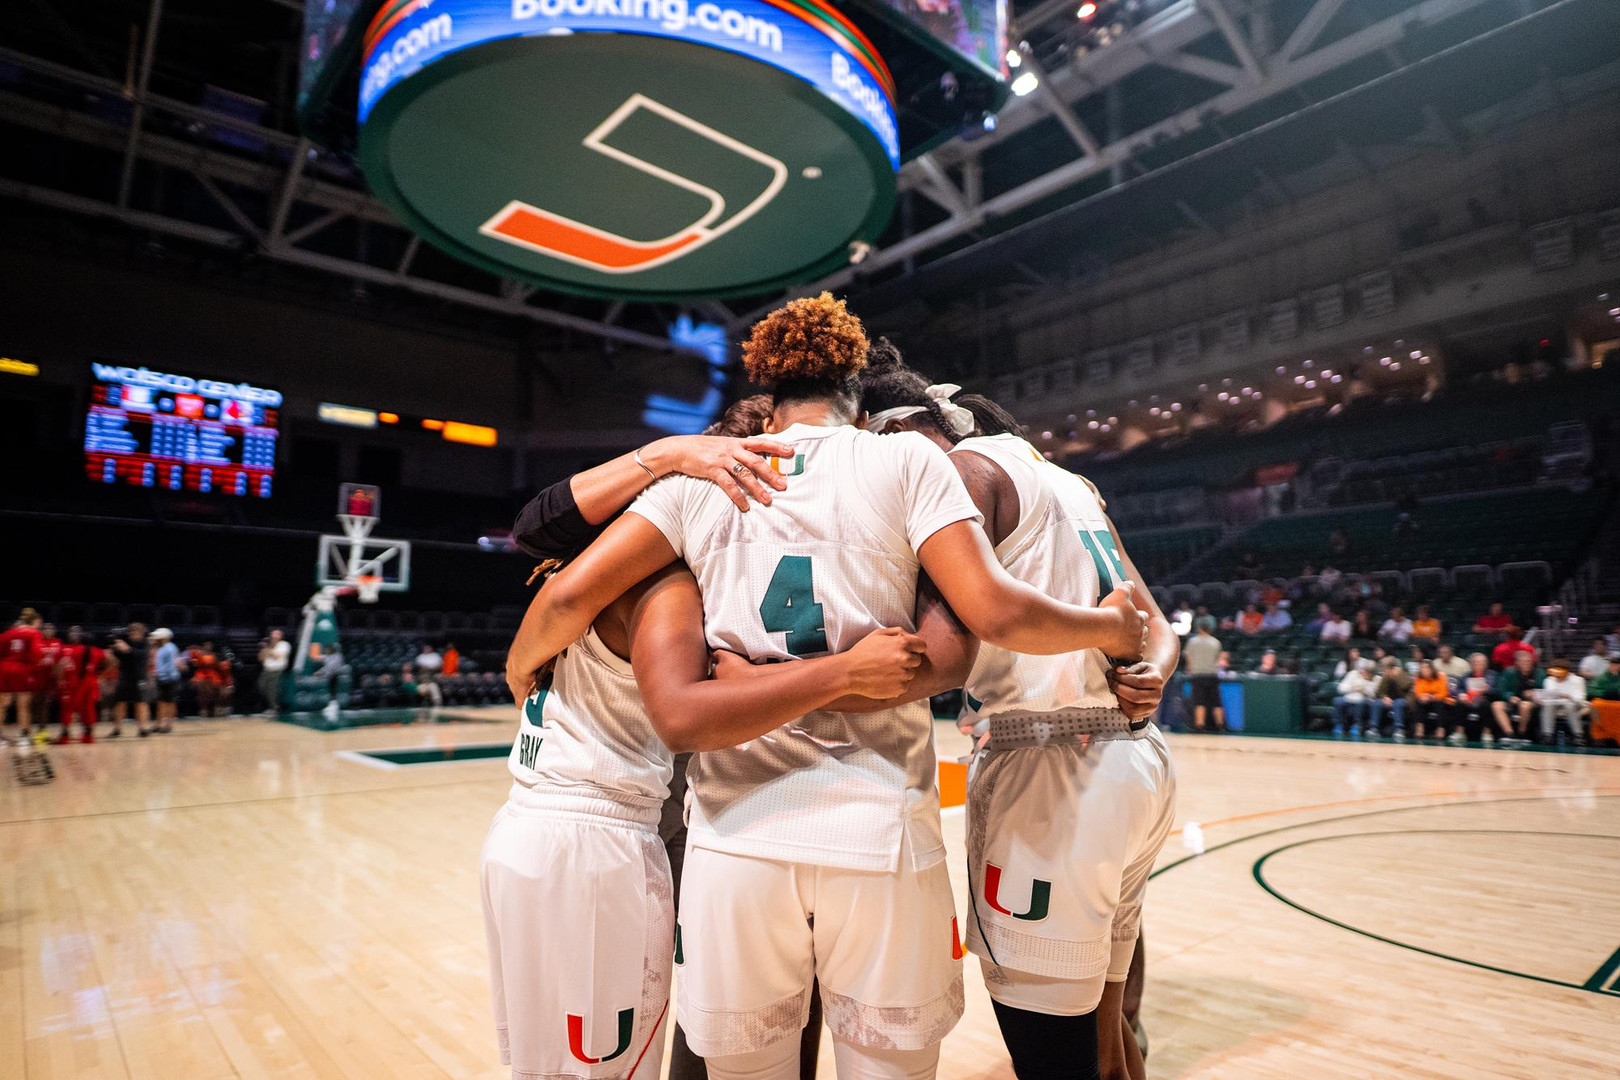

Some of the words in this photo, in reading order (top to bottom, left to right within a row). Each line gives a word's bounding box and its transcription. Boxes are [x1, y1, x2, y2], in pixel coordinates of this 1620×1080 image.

[759, 554, 829, 655] 4
[519, 733, 544, 771] GRAY
[983, 861, 1052, 922] U
[565, 1006, 635, 1066] U
